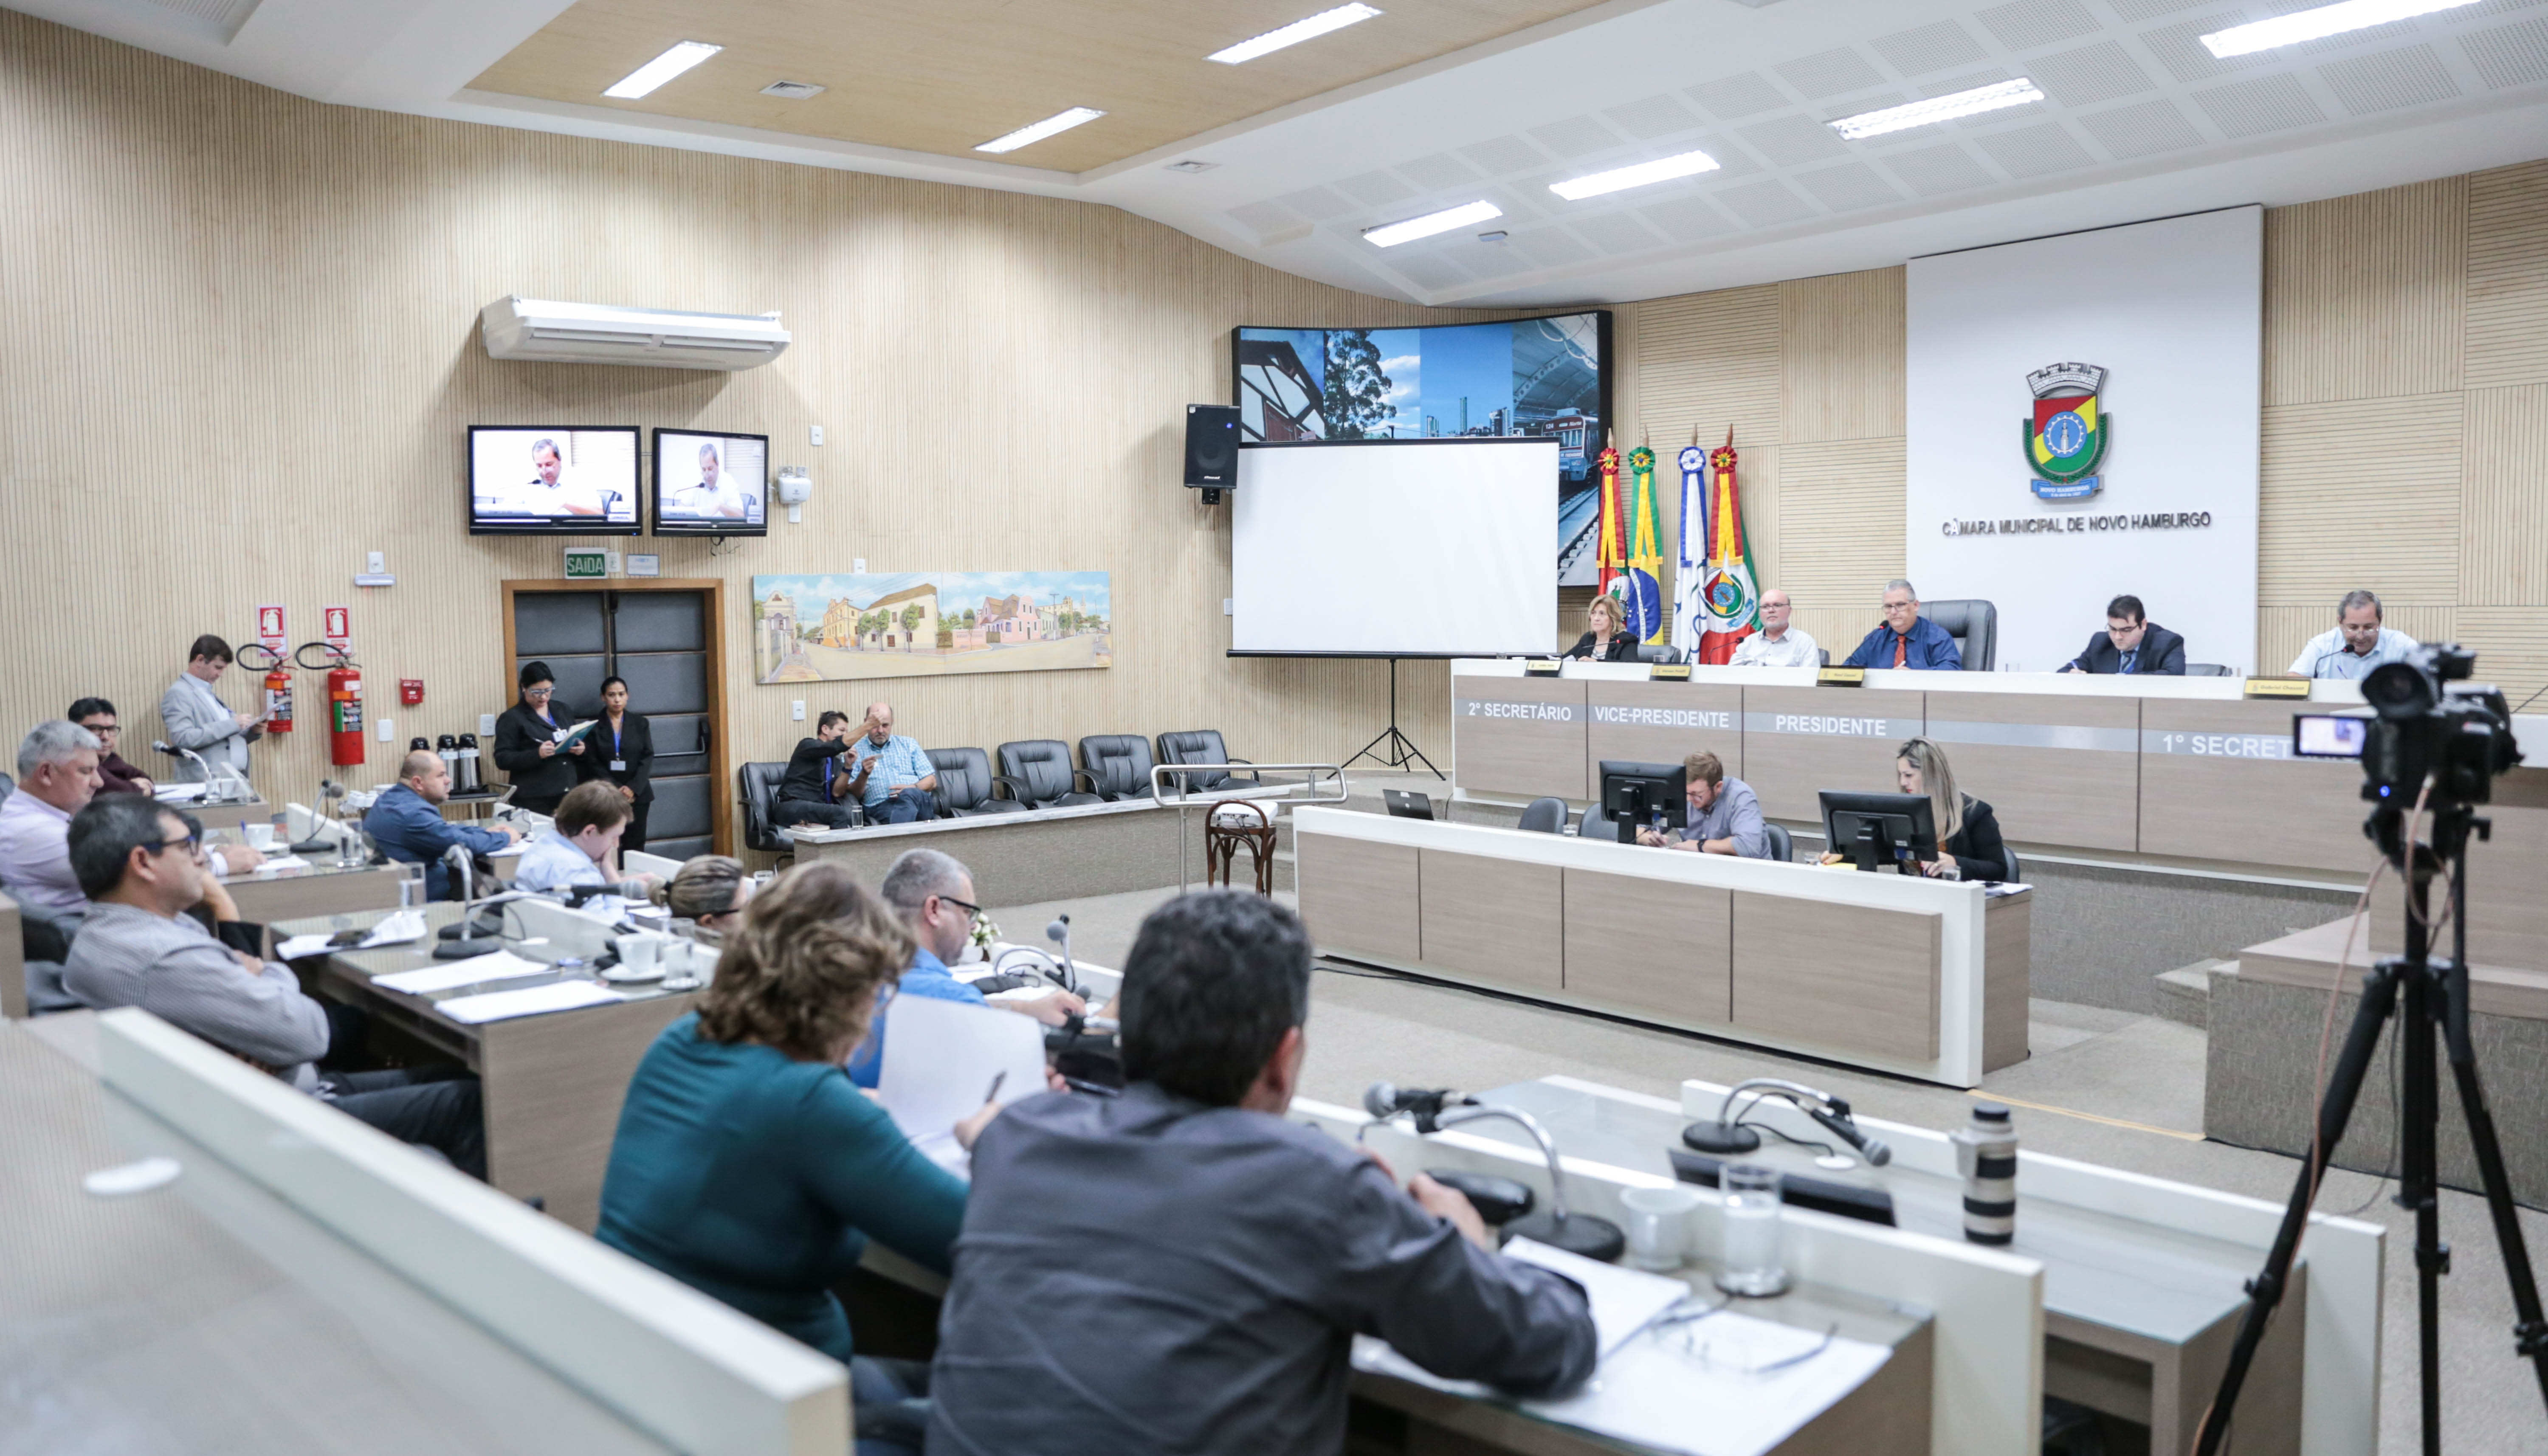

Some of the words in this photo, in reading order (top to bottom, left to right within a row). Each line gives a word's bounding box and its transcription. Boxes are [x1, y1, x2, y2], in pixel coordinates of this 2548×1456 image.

[1999, 517, 2063, 533] MUNICIPAL
[2067, 517, 2084, 531] DE
[2089, 515, 2128, 530] NOVO
[2131, 511, 2211, 529] HAMBURGO
[1484, 702, 1572, 721] SECRETÁRIO
[1594, 706, 1730, 728] VICE-PRESIDENTE
[1776, 715, 1886, 736] PRESIDENTE
